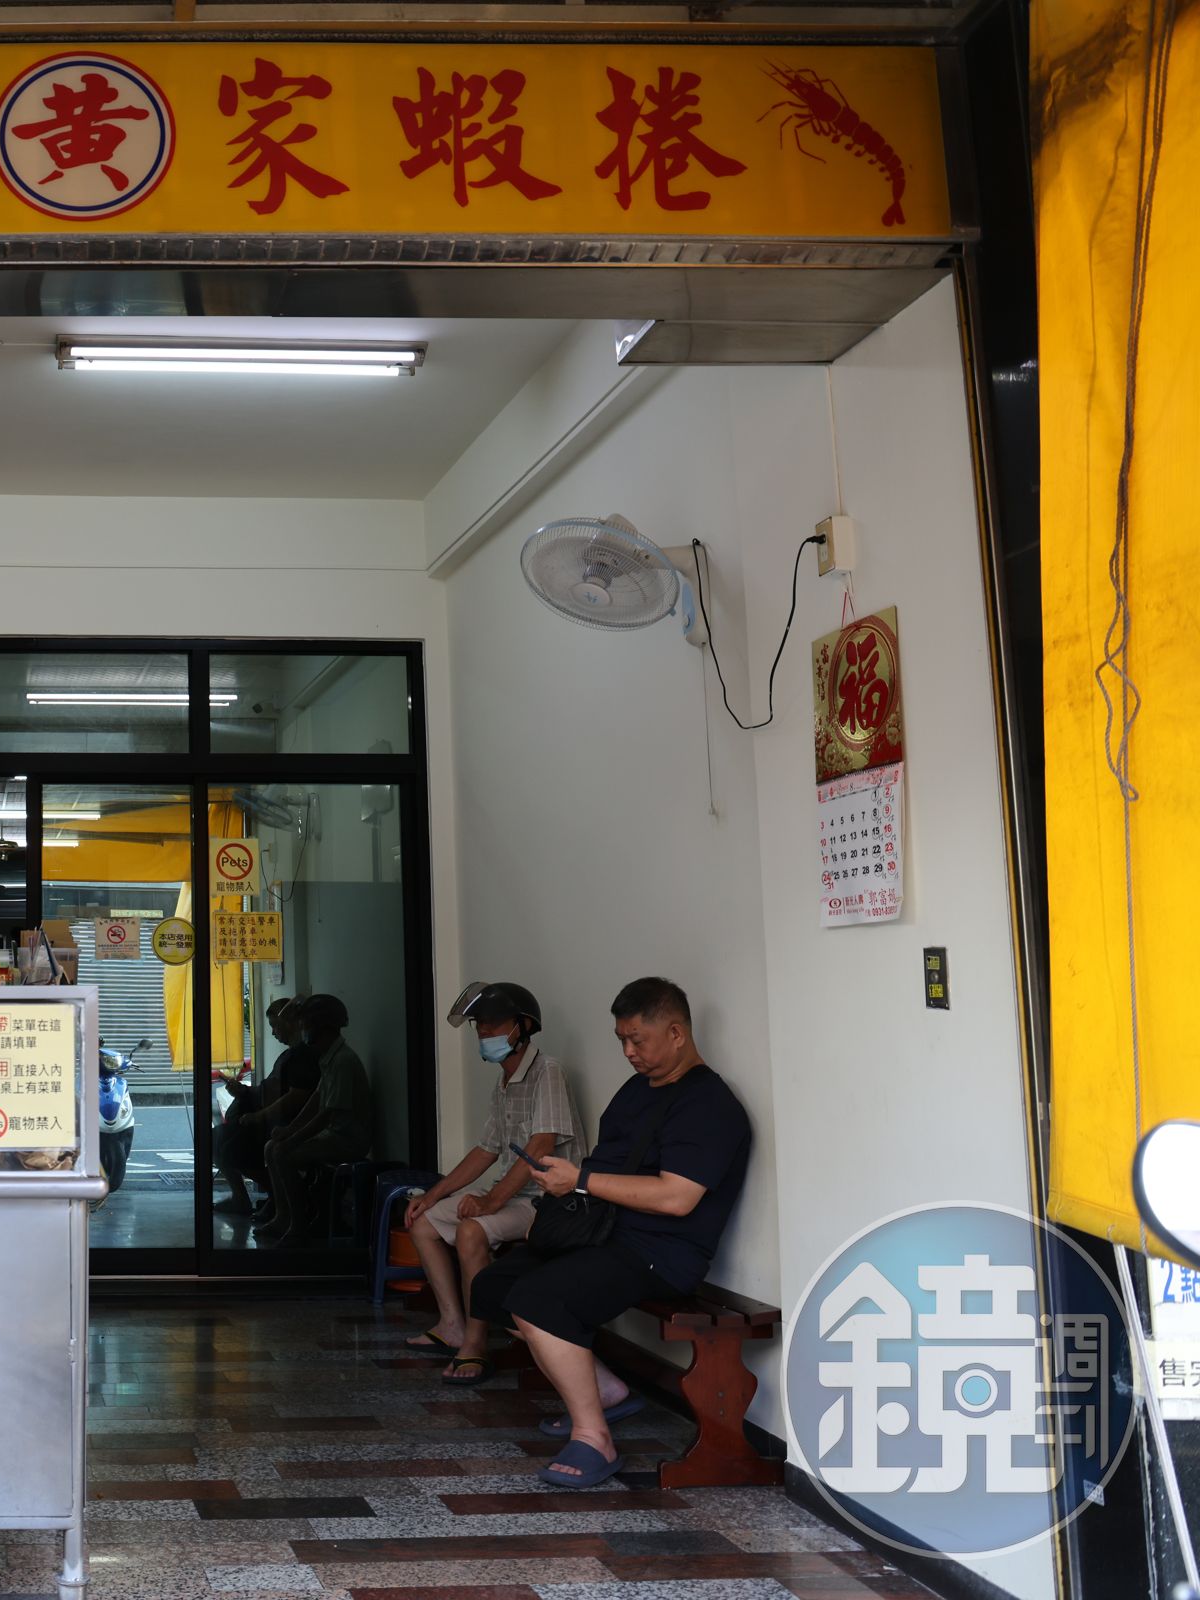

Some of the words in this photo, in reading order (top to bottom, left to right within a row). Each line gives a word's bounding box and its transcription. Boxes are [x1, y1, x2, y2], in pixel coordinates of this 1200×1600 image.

[838, 631, 889, 735] 福
[221, 857, 248, 868] Pets
[216, 881, 254, 892] 寵物禁入
[12, 1019, 61, 1032] 菜單在這
[0, 1036, 37, 1049] 請填單
[8, 1116, 62, 1131] 寵物禁入
